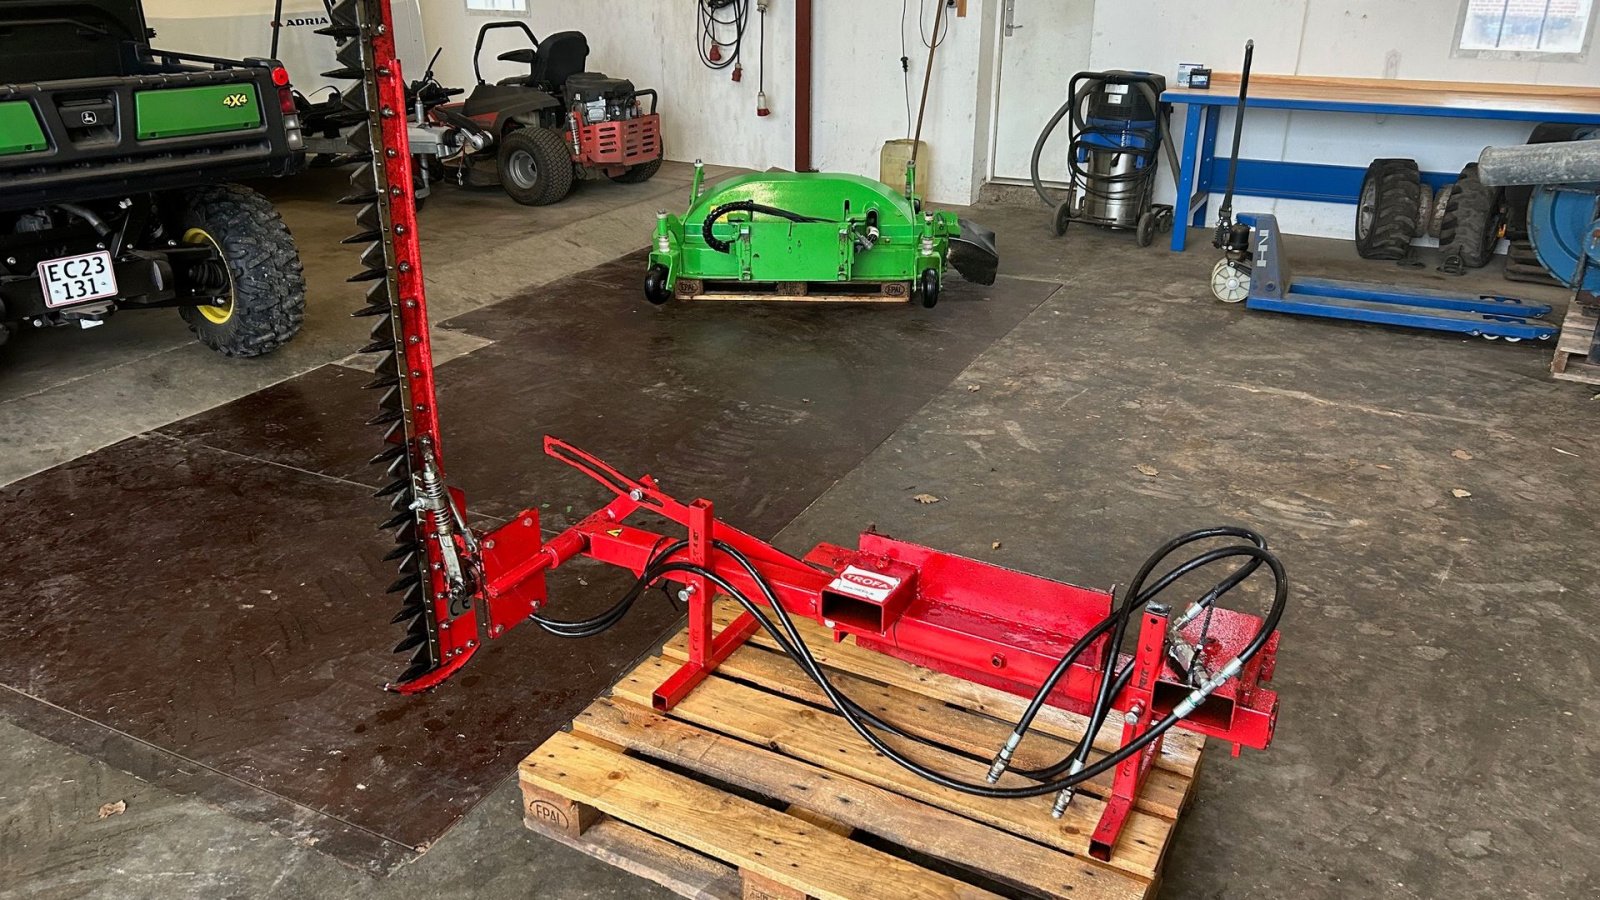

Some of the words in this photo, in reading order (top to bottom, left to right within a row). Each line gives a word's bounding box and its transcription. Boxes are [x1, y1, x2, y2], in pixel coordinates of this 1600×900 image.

[286, 17, 329, 27] ADRIA
[47, 256, 105, 282] EC23
[62, 278, 99, 300] 131
[846, 574, 889, 589] TROFA
